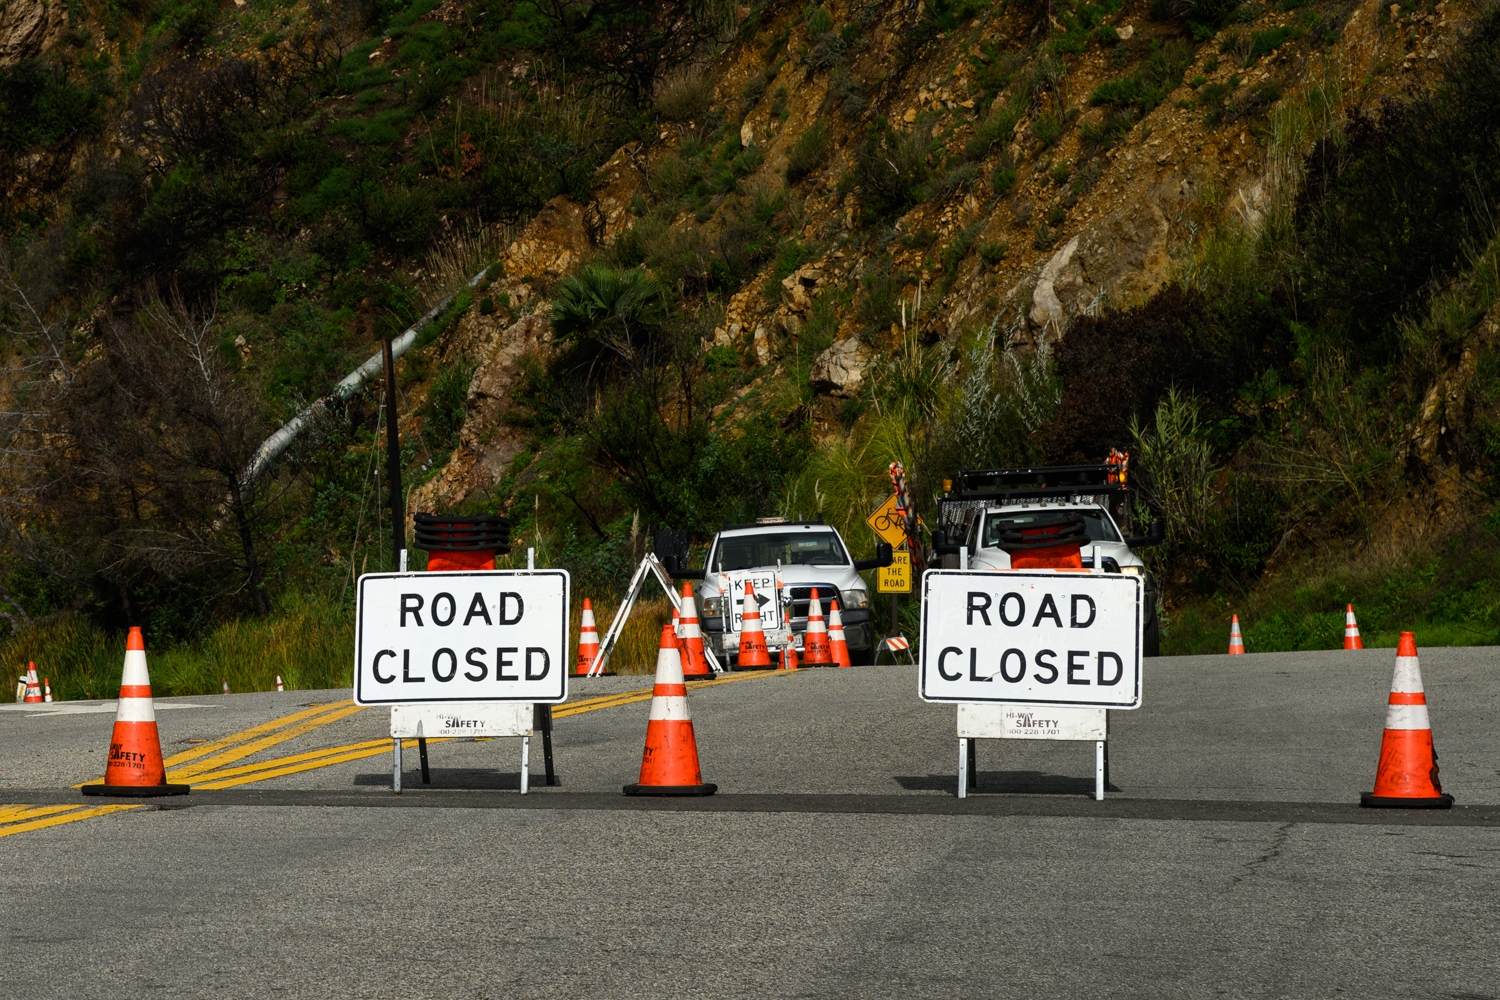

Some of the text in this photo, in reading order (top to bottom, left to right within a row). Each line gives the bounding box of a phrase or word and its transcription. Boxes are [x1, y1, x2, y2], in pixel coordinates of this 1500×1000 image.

[892, 556, 907, 564] ARE
[735, 578, 769, 590] KEP
[884, 579, 905, 587] ROAD
[400, 592, 524, 627] ROAD
[966, 591, 1096, 628] ROAD
[735, 610, 774, 623] RHT
[372, 647, 550, 684] CLOSED
[938, 646, 1123, 686] CLOSED
[445, 719, 486, 728] SAFETY
[1016, 719, 1059, 728] SAFETY
[110, 751, 146, 762] SAFETY
